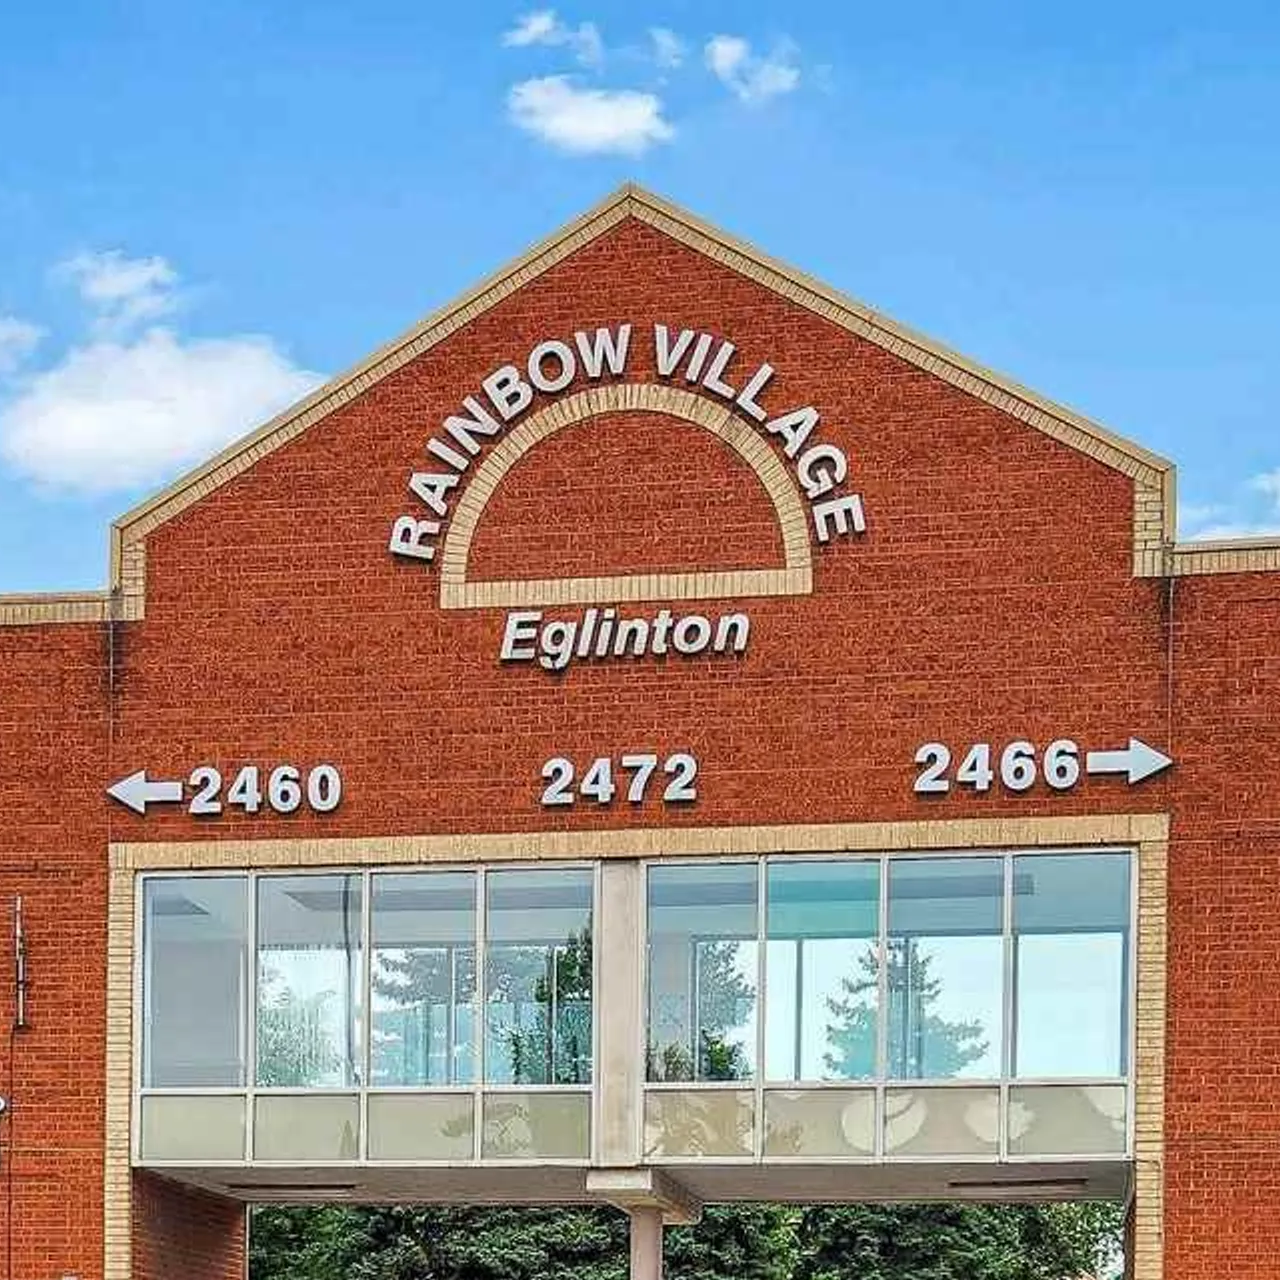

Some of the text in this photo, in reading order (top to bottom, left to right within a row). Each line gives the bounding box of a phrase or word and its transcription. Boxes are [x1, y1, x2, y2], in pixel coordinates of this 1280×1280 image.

[389, 324, 866, 560] RAINBOW VILLAGE
[499, 607, 750, 669] Eglinton
[187, 764, 343, 815] 2460
[540, 753, 699, 805] 2472
[913, 739, 1080, 792] 2466
